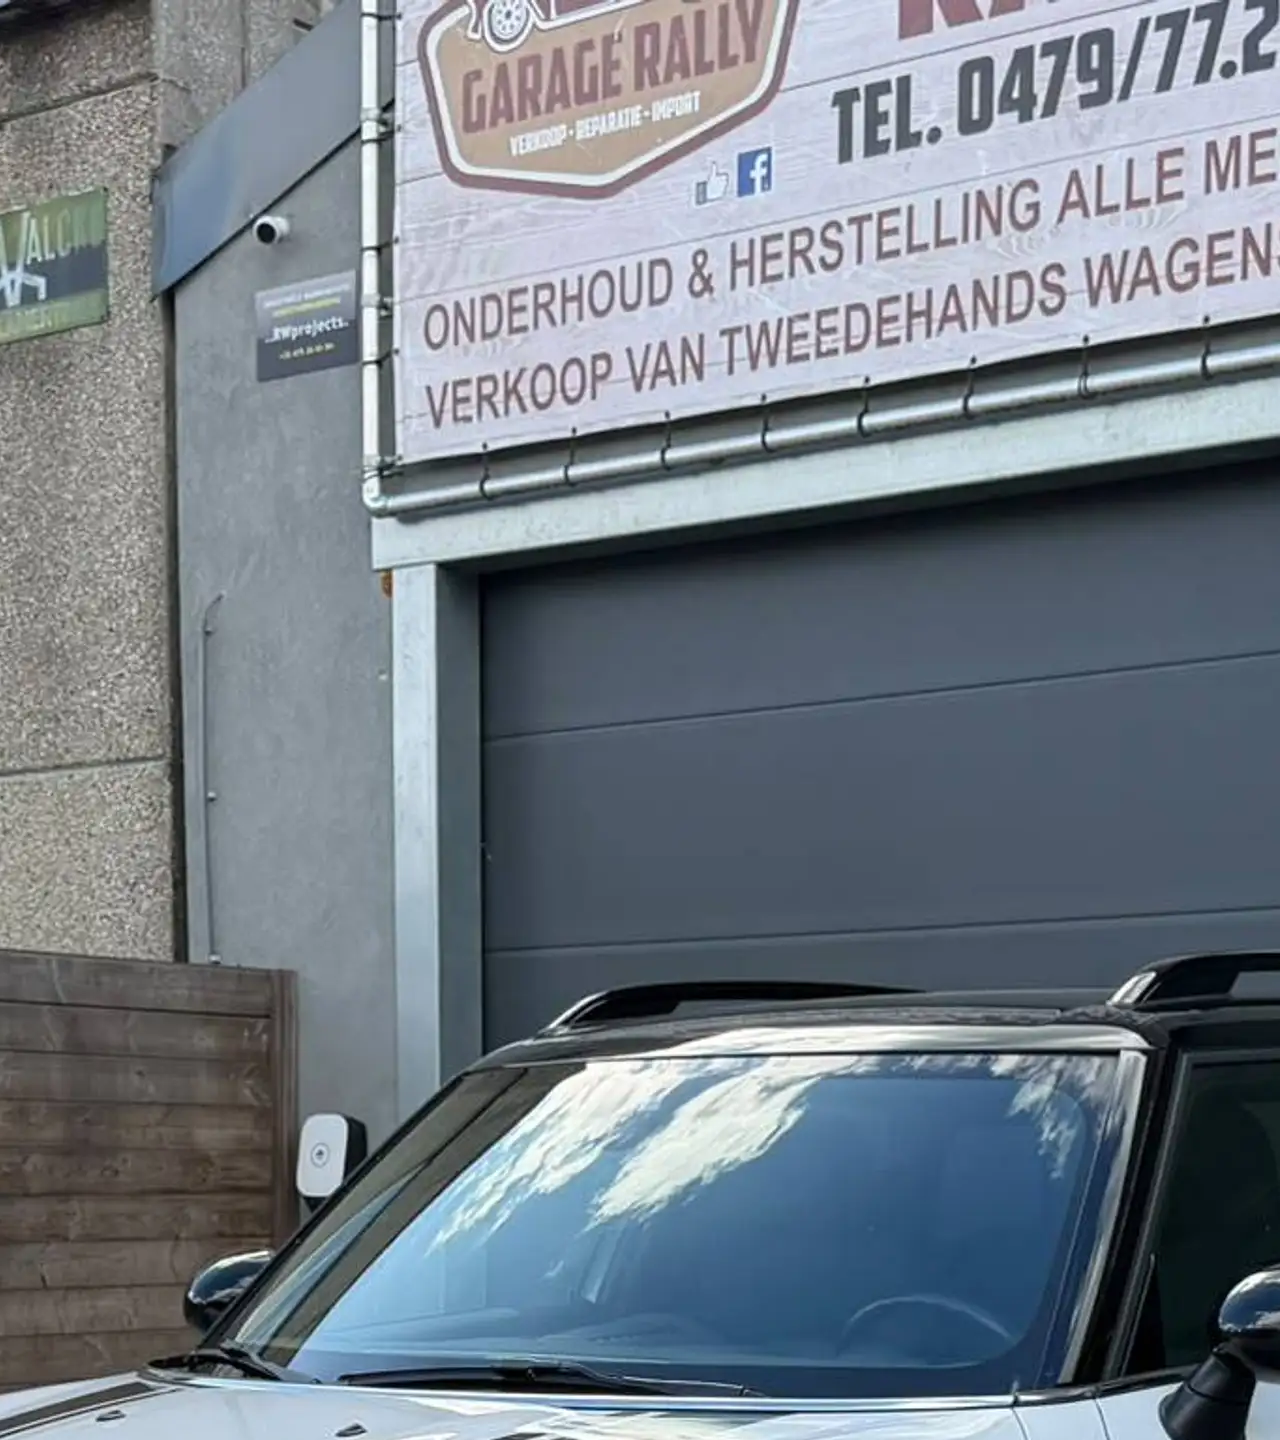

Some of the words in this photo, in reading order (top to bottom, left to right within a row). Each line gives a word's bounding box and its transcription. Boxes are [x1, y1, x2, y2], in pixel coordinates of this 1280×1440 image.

[462, 31, 623, 134] GARAGE
[634, 0, 765, 92] RALLY
[831, 74, 943, 165] TEL.
[424, 256, 674, 351] ONDERHOUD
[687, 248, 715, 299] &
[730, 177, 1041, 292] HERSTELLING
[1057, 147, 1185, 226] ALLE
[426, 351, 614, 430] VERKOOP
[626, 332, 706, 393] VAN
[720, 261, 1067, 376] TWEEDEHANDS
